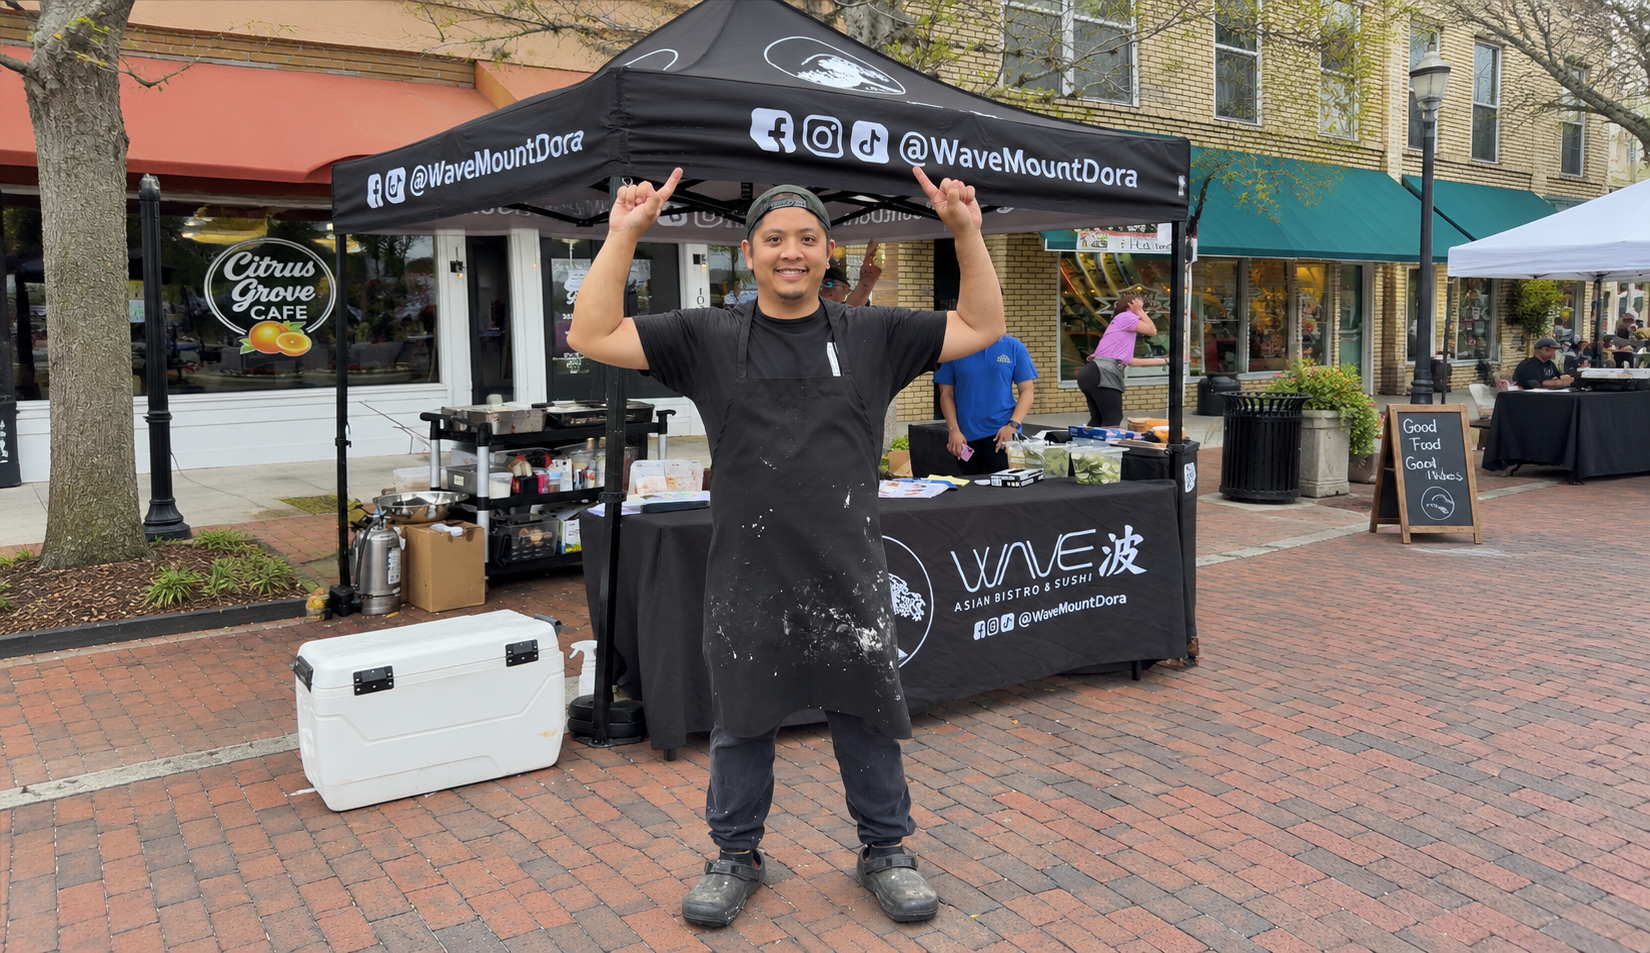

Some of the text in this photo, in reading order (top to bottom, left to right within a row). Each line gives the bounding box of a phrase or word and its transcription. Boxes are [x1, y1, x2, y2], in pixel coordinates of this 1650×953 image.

[410, 130, 585, 197] @WaveMountDora
[899, 131, 1138, 188] @WaveMountDora
[223, 251, 315, 281] Citrus
[231, 278, 316, 312] Grove
[250, 305, 307, 320] CAFE
[1403, 418, 1437, 434] Good
[1409, 437, 1441, 451] Food
[950, 524, 1147, 593] WAVE 波
[954, 573, 1093, 612] ASIAN BISTRO & SUSHI
[1018, 593, 1127, 628] @WaveMountDora
